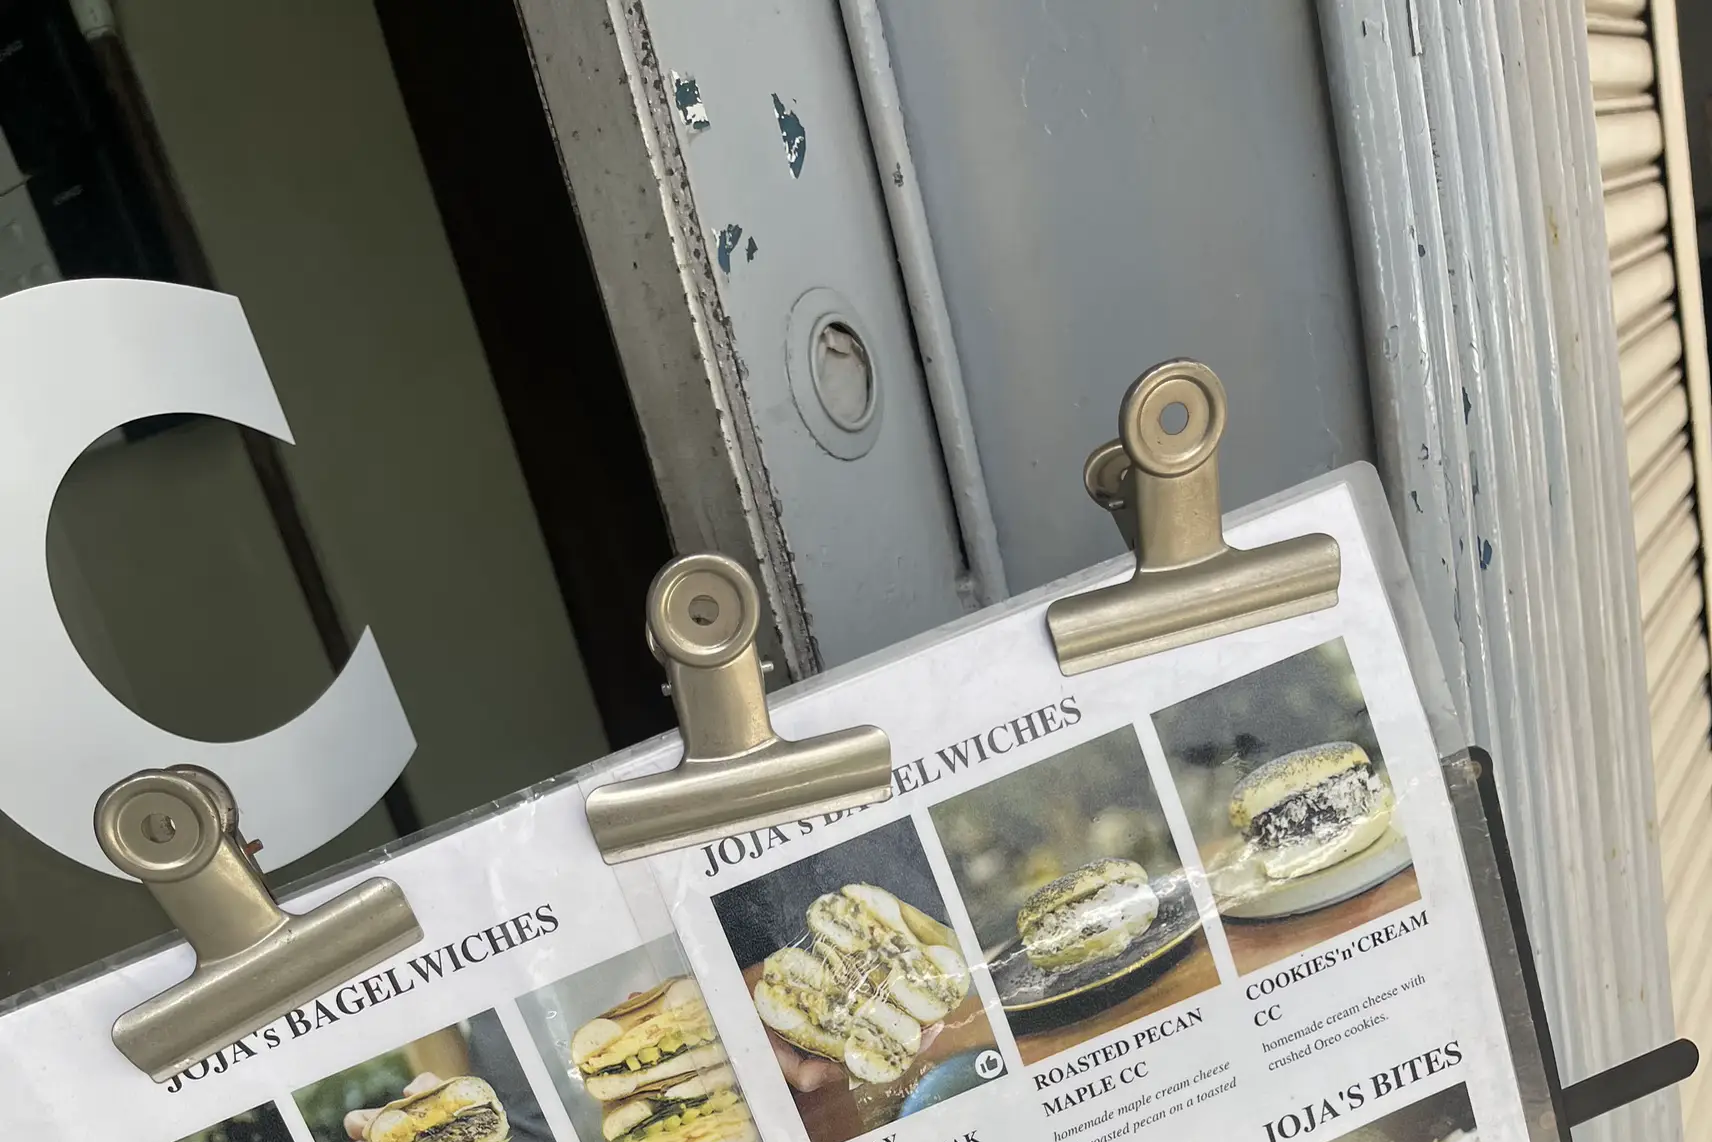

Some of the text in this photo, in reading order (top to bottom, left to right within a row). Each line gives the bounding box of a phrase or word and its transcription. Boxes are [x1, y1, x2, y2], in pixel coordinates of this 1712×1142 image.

[700, 696, 1083, 877] JOJAs ELWICHES
[285, 903, 559, 1039] BAGELWICHES
[1246, 910, 1428, 1000] COOKIES'n'CREAM
[1033, 1007, 1203, 1091] ROASTED PECAN
[1254, 1004, 1282, 1027] CC
[1261, 974, 1425, 1053] homemade cream cheese with
[1268, 1013, 1388, 1071] crushed Oreo cookies.
[1042, 1061, 1148, 1117] MAPLE CC
[1053, 1061, 1230, 1142] homemade maple cream cheese
[1133, 1110, 1166, 1133] pecan
[1196, 1076, 1236, 1103] toasted
[1369, 1040, 1462, 1099] BITES
